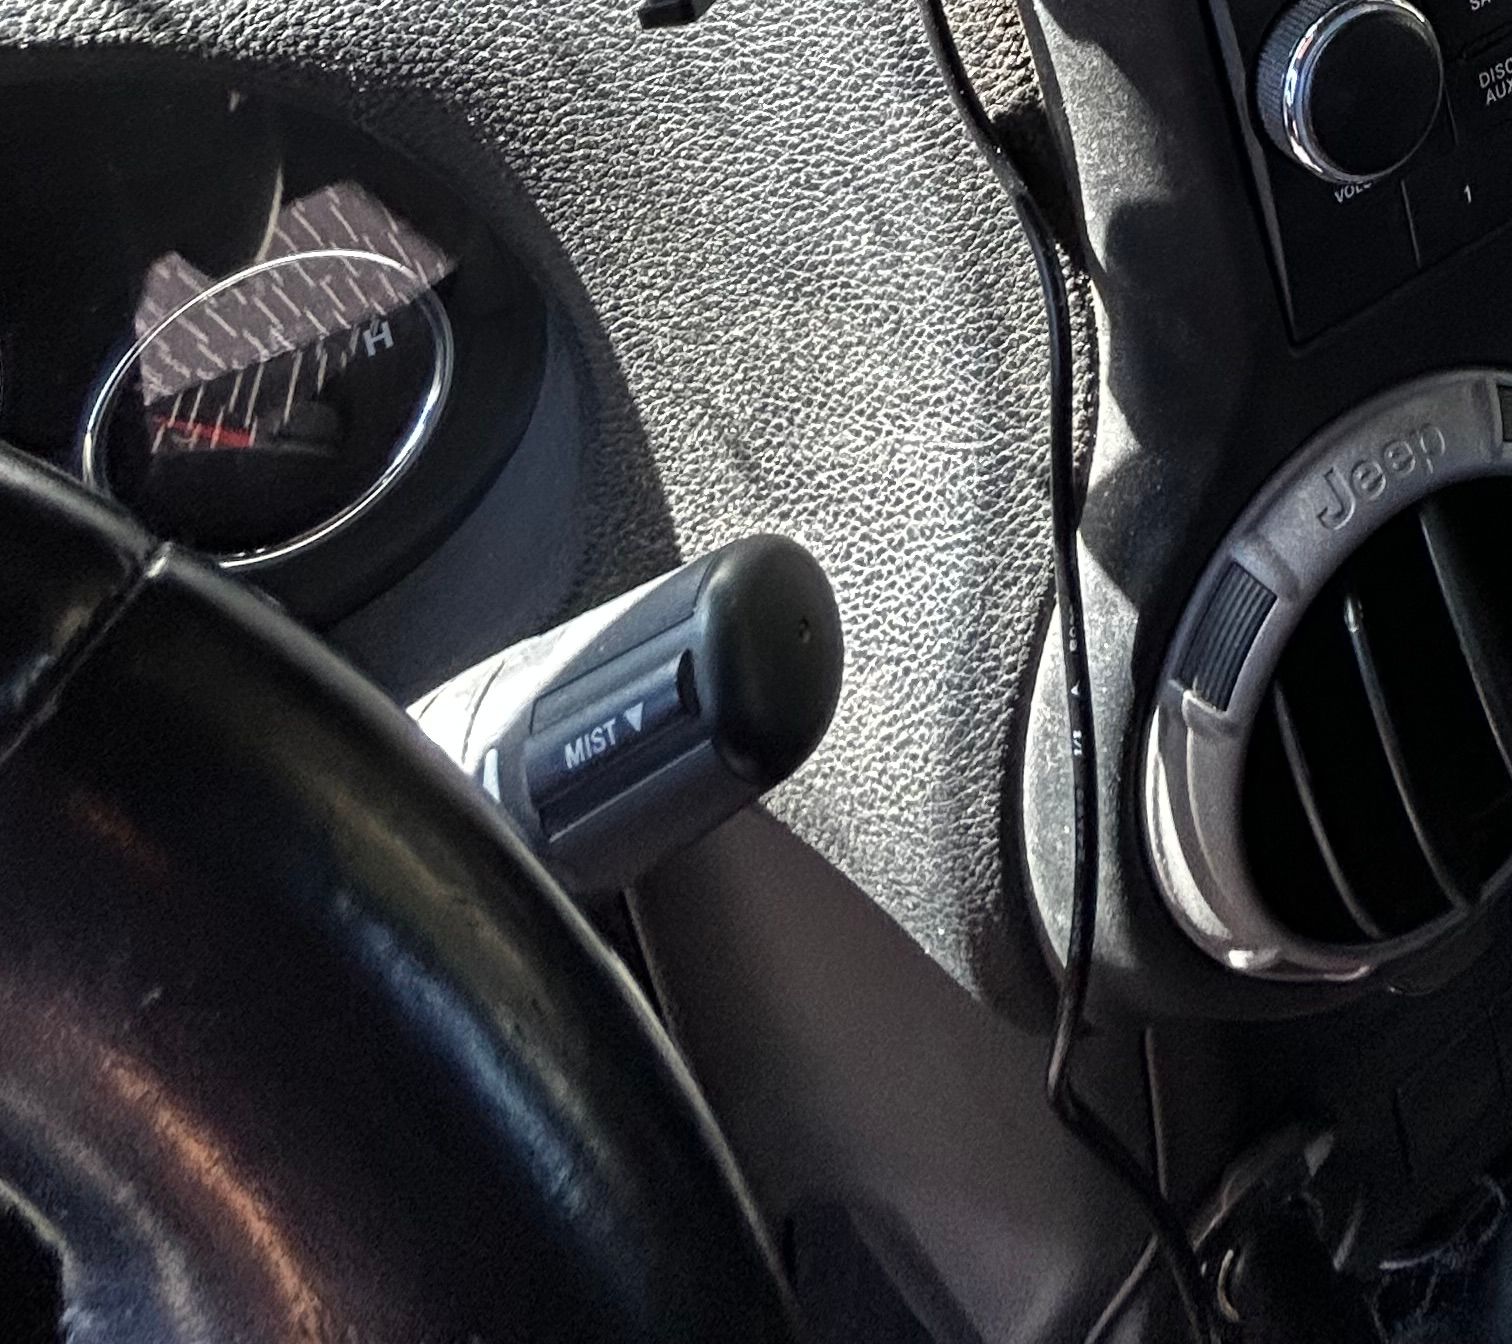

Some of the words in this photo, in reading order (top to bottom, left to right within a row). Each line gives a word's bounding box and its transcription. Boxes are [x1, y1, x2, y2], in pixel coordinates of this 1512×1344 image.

[1464, 184, 1472, 203] 1
[361, 319, 394, 357] H
[1316, 423, 1446, 530] Jeep
[564, 717, 617, 769] MIST
